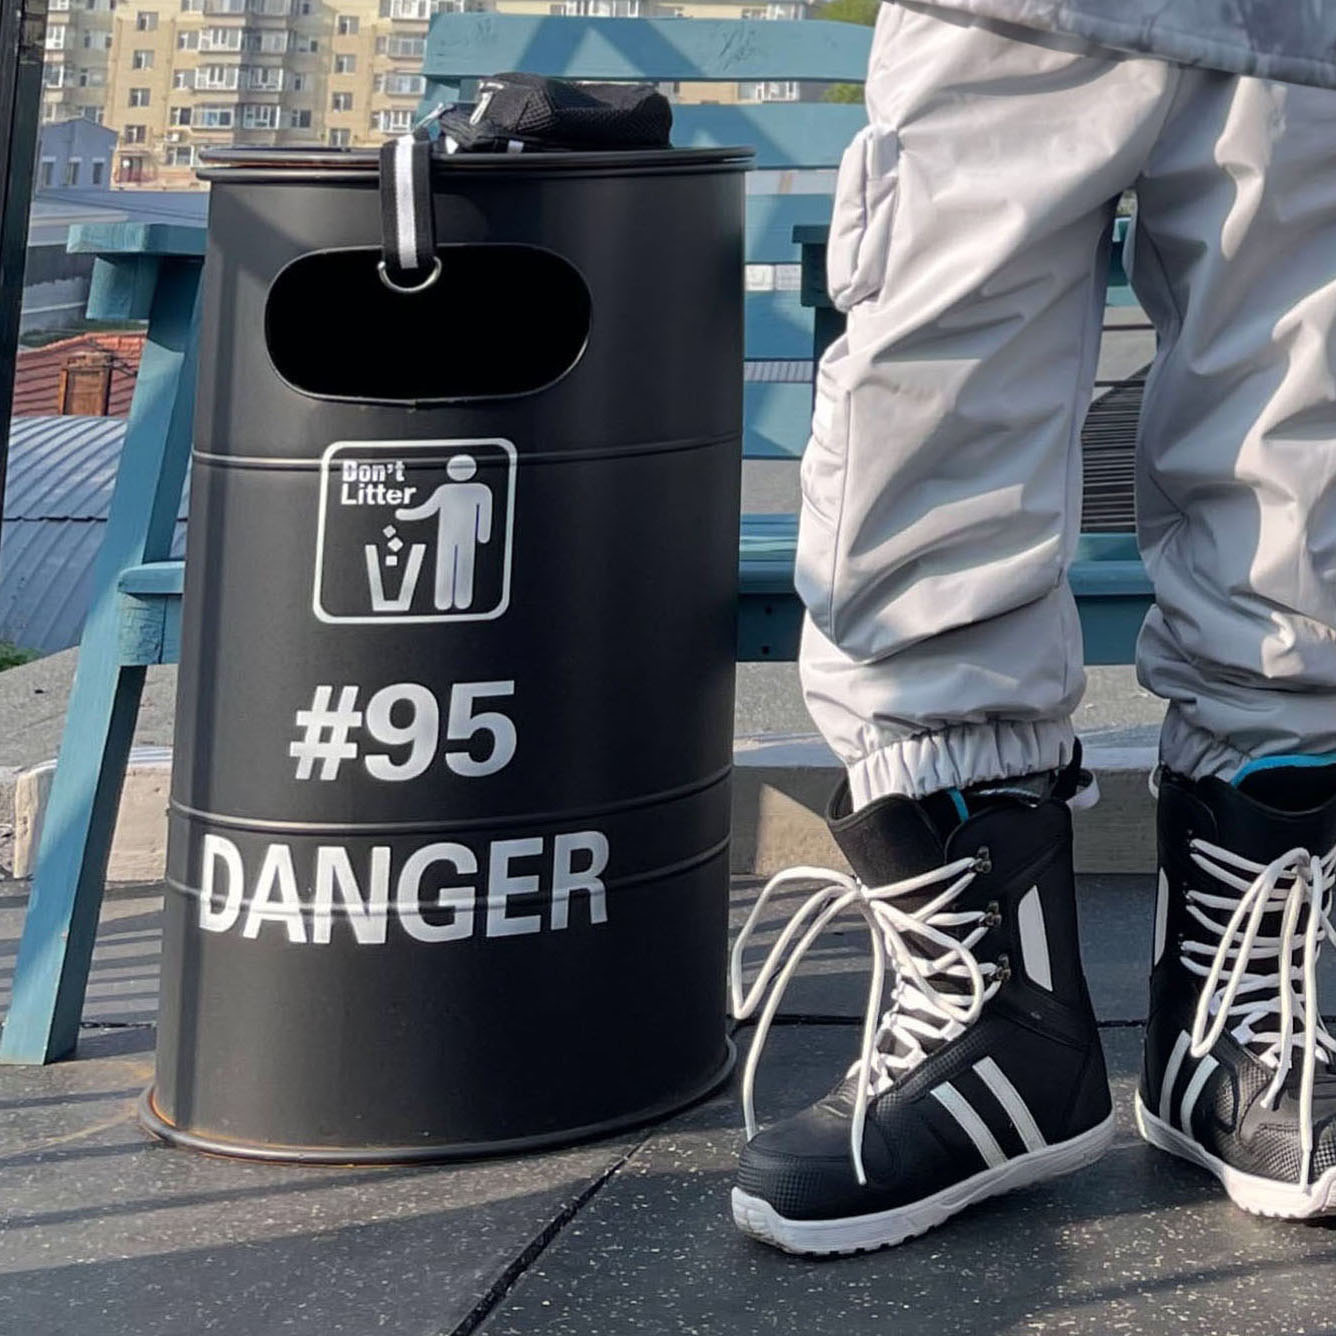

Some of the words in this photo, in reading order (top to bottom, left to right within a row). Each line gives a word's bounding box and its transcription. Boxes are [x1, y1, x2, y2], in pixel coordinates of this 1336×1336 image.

[341, 483, 417, 505] Litter
[342, 460, 406, 482] Don't
[290, 680, 518, 782] #95
[199, 830, 610, 945] DANGER
